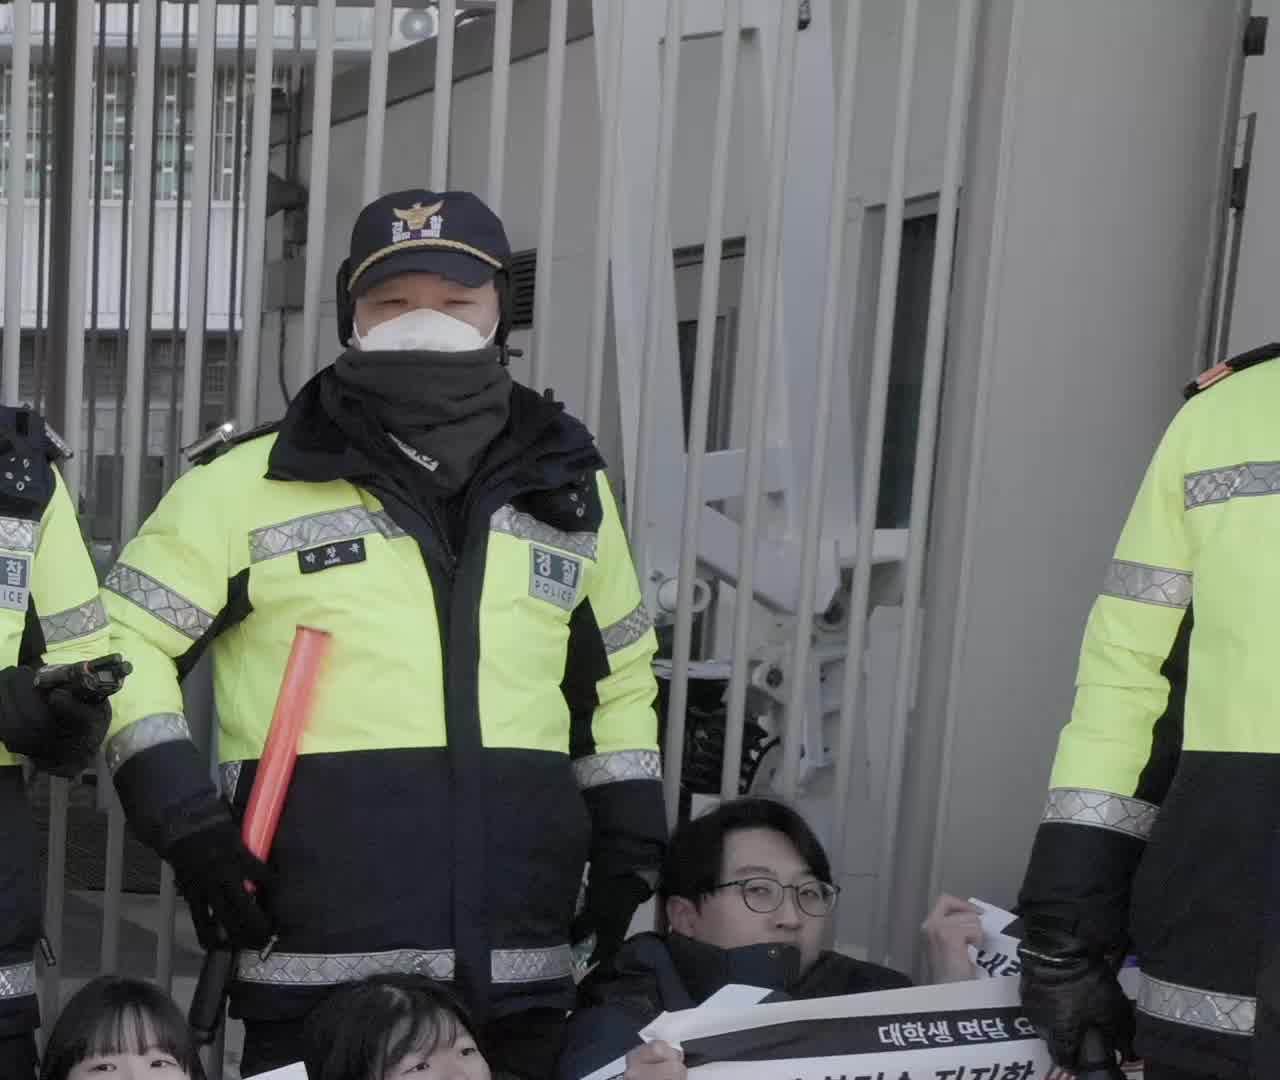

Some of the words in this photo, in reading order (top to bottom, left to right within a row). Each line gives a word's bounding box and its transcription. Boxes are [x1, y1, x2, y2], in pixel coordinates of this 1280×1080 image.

[535, 550, 577, 587] 경찰
[535, 579, 573, 604] POLICE
[877, 1020, 954, 1047] 대학생
[957, 1017, 1009, 1041] 면담
